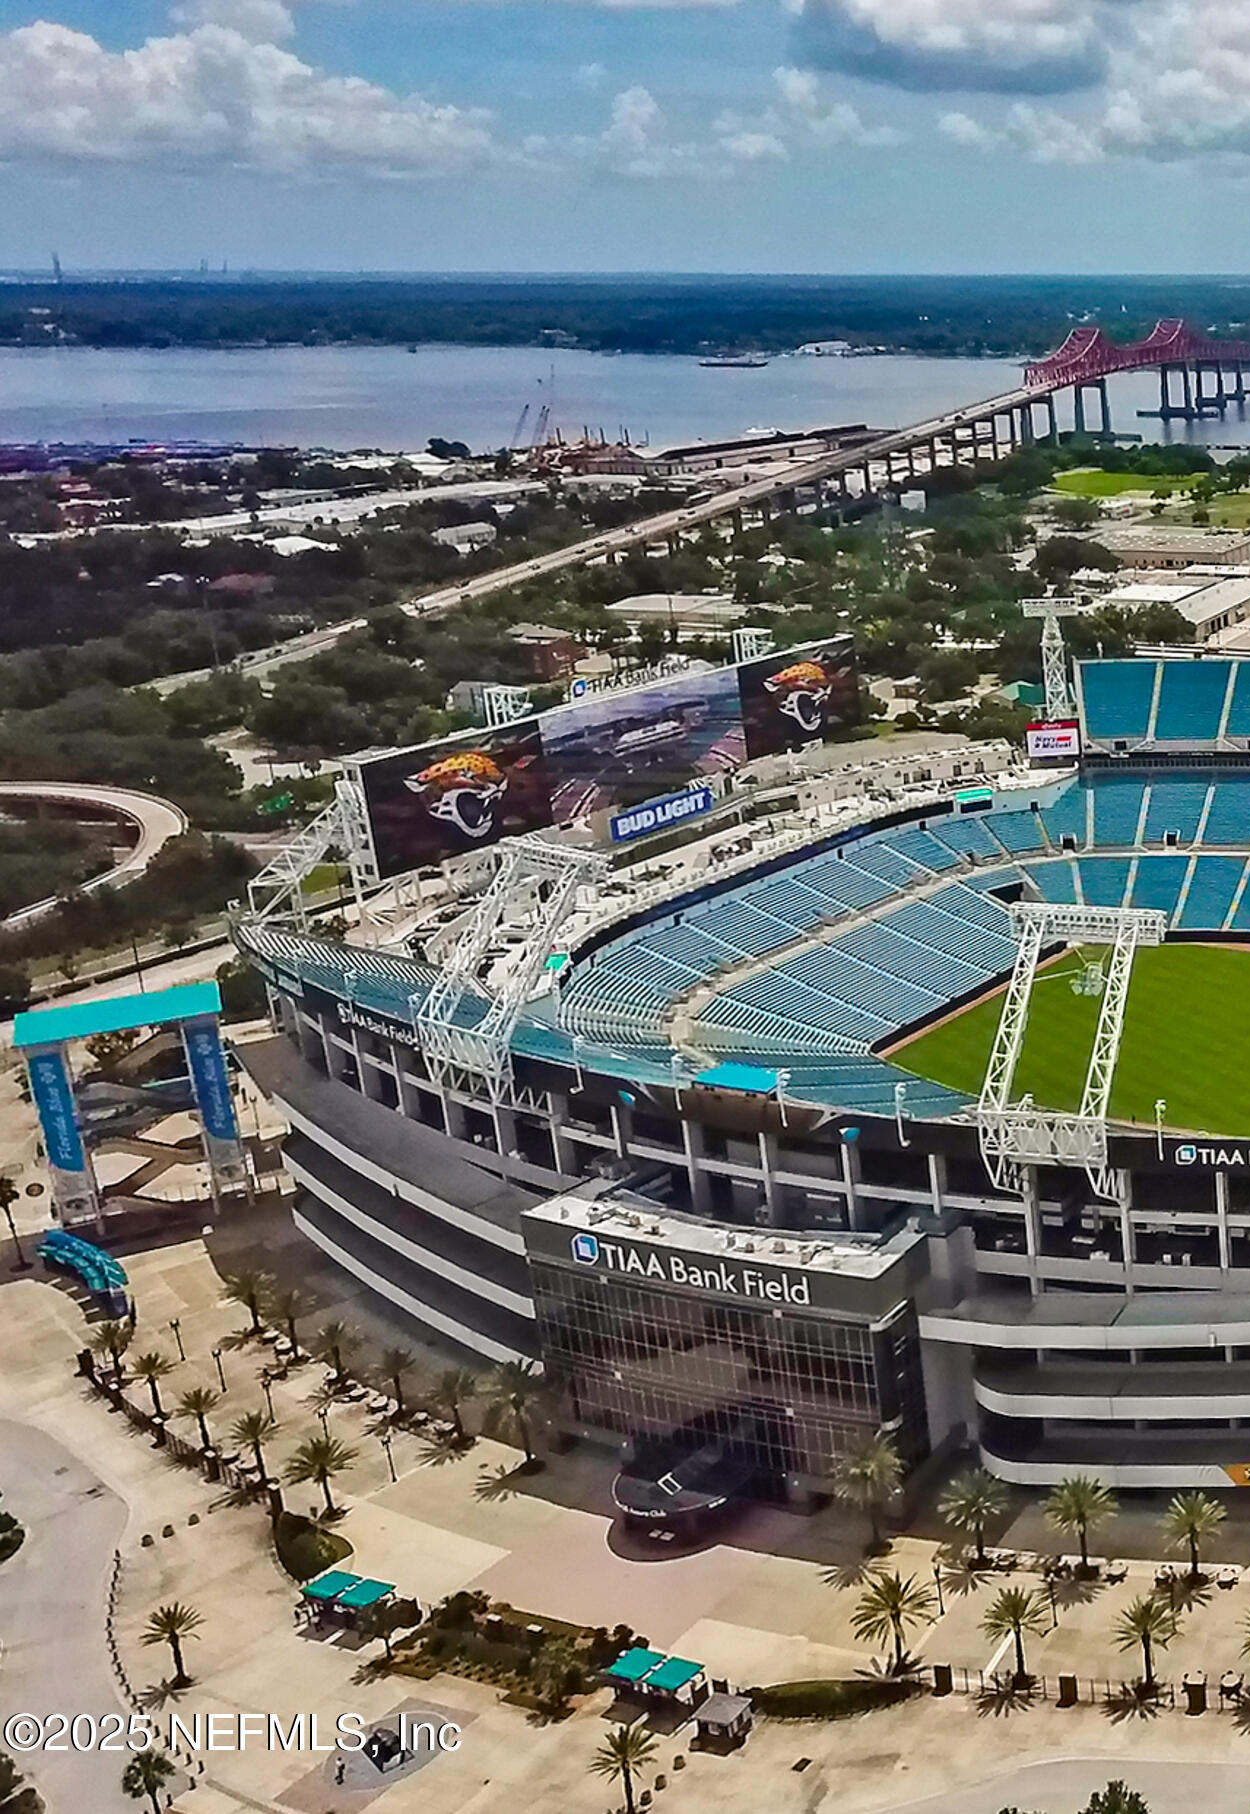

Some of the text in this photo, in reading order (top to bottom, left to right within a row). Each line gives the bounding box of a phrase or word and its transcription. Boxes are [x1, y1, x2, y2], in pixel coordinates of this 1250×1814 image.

[588, 656, 690, 693] TIAA Bank Field
[617, 792, 705, 836] BUD LIGHT
[49, 1086, 73, 1160] Florida Blue
[1198, 1148, 1245, 1166] TIAA
[600, 1242, 810, 1305] TIAA Bank Field
